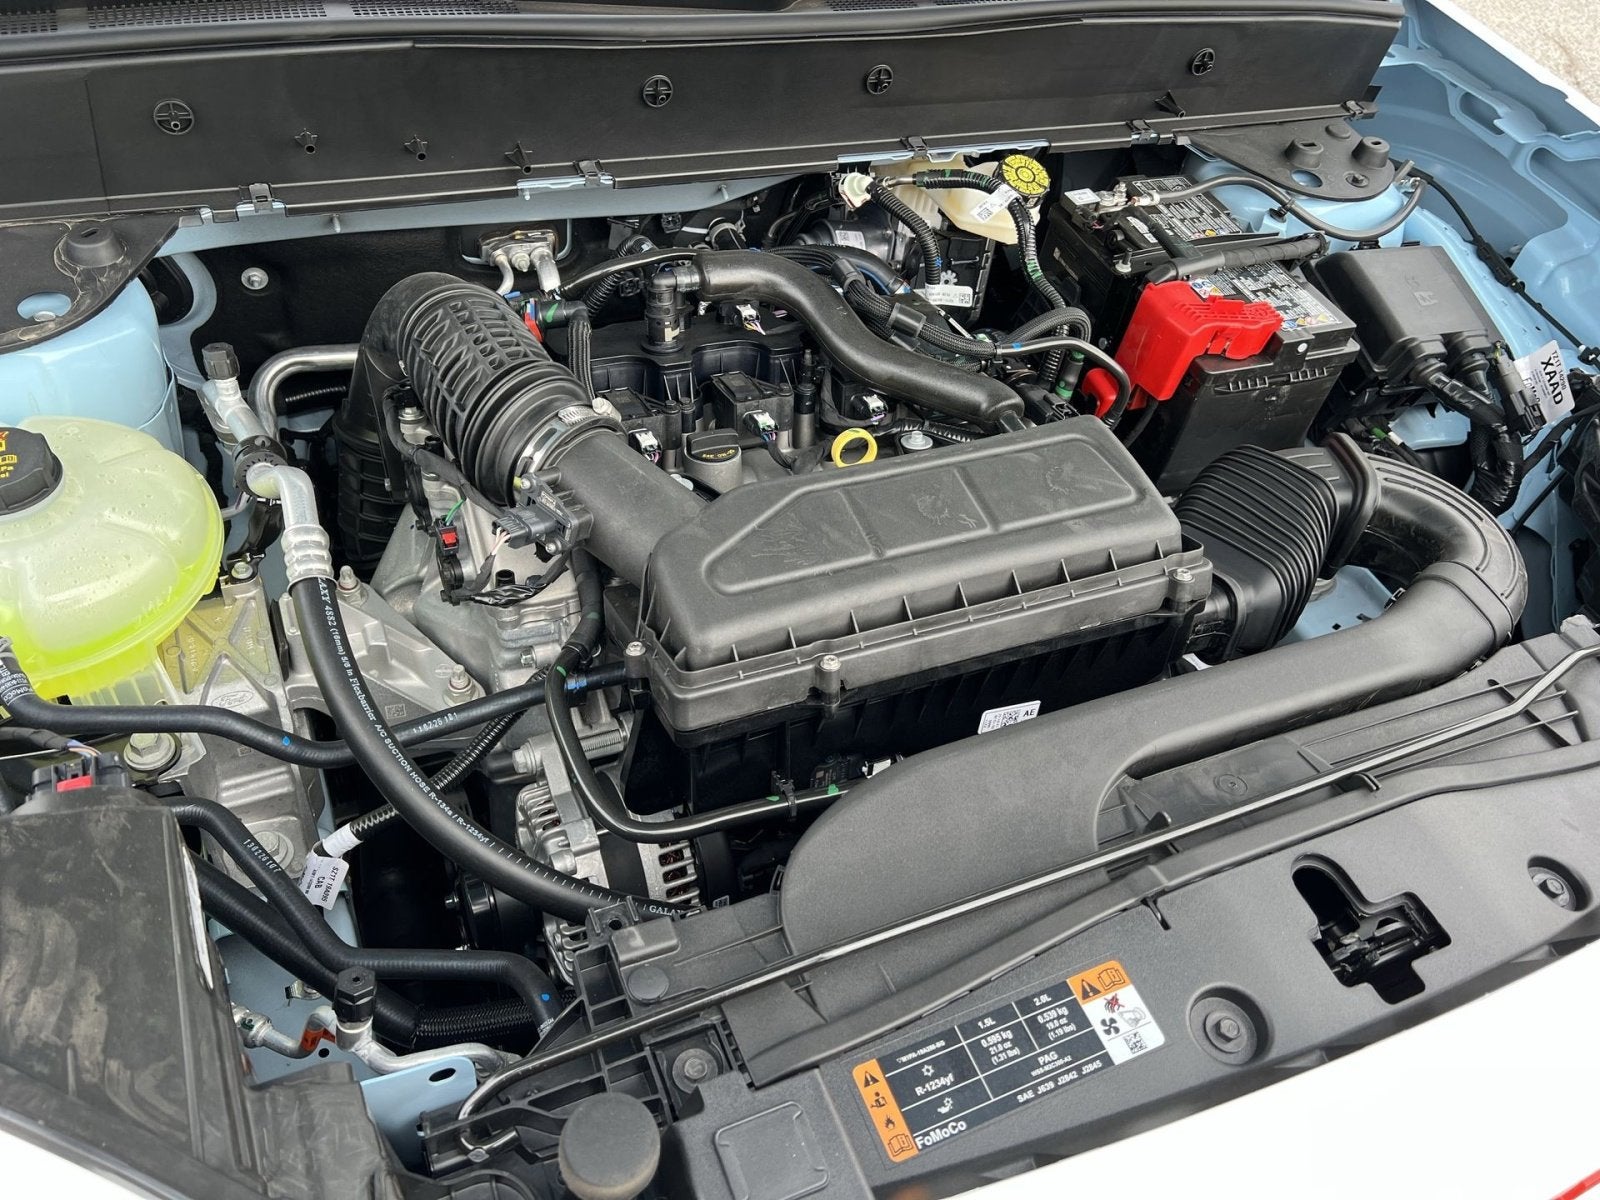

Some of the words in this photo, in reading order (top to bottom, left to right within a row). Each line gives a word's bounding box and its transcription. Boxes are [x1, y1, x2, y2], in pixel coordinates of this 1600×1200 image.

[1541, 356, 1563, 405] XAAD
[1023, 709, 1036, 717] AE
[349, 678, 377, 721] Flexbarrier
[384, 738, 412, 772] SUCTION
[409, 771, 431, 793] HOSE
[649, 905, 680, 916] GALA
[1033, 993, 1052, 1006] 2.0L
[1055, 1006, 1069, 1016] kg
[977, 1016, 996, 1029] 1.5L
[1059, 1017, 1069, 1025] oz
[1000, 1029, 1013, 1040] kg
[1003, 1041, 1013, 1049] oz
[1037, 1051, 1059, 1066] PAG
[914, 1072, 954, 1096] R-1234yf
[1016, 1089, 1036, 1103] SAE
[1037, 1081, 1055, 1095] J639
[1057, 1070, 1079, 1086] J2842
[1081, 1059, 1103, 1075] J2845
[914, 1121, 967, 1150] FoMoCo
